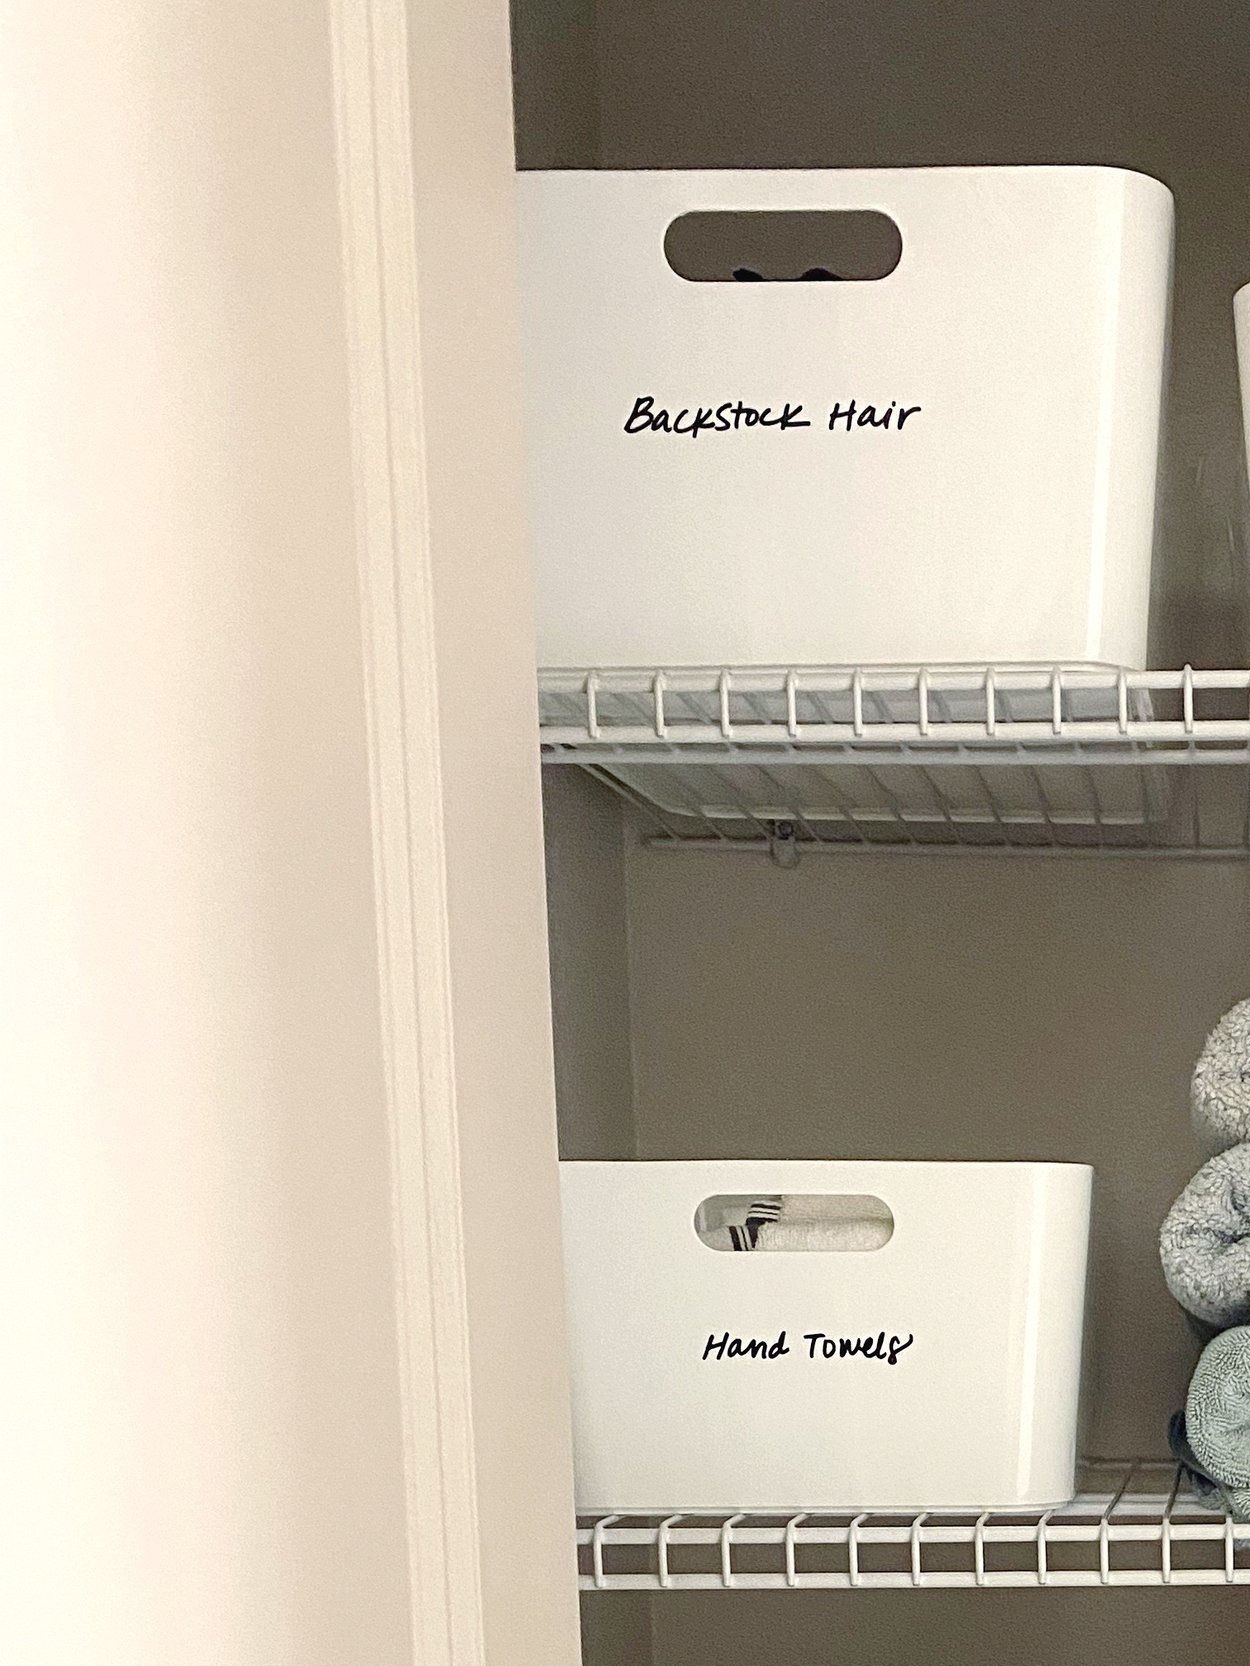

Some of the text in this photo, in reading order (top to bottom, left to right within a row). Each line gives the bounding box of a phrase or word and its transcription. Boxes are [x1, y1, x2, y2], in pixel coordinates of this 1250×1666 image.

[624, 396, 921, 438] Backstock Hair
[702, 1330, 913, 1365] Hand Towels
